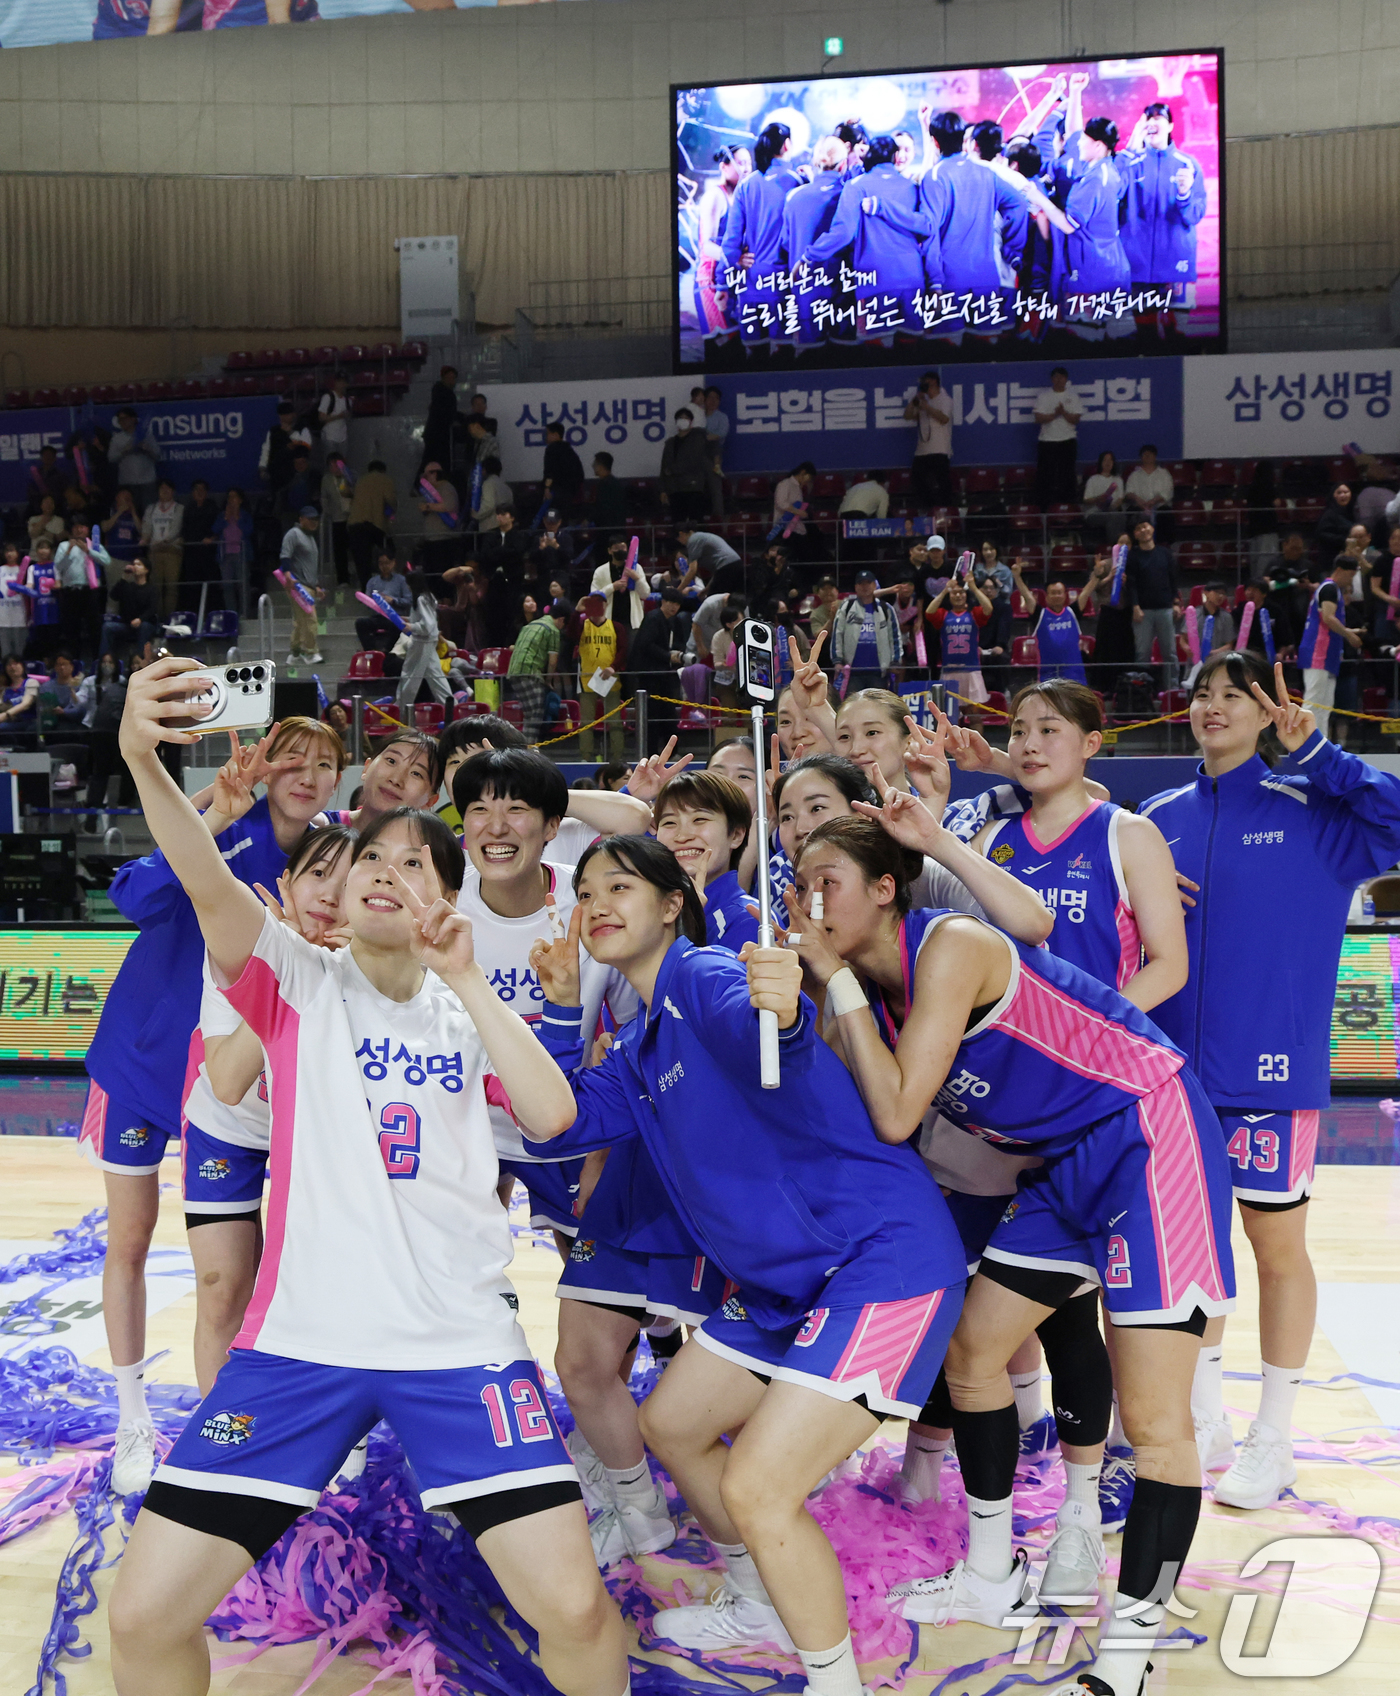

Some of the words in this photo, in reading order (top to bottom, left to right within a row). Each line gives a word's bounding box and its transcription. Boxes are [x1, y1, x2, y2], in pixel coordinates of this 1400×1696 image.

[723, 266, 748, 294] 팬
[755, 263, 834, 295] 여러분과
[838, 259, 878, 293] 함께
[740, 294, 802, 335] 승리를
[810, 294, 905, 331] 뛰어넘는
[911, 287, 1008, 329] 챔프전을
[1011, 289, 1059, 322] 향해
[1066, 286, 1174, 321] 가겠습니다!
[736, 387, 867, 434] 보험을
[1225, 370, 1392, 422] 삼성생명
[515, 396, 666, 447] 삼성생명
[169, 447, 226, 462] Networks
[947, 633, 971, 655] 25
[1242, 830, 1285, 846] 삼성생명
[355, 1037, 464, 1093] 성생명
[657, 1060, 685, 1093] 삼성생명
[1257, 1053, 1290, 1082] 23
[368, 1099, 421, 1180] 2
[1227, 1126, 1280, 1173] 43
[1105, 1233, 1133, 1289] 2
[204, 1418, 231, 1431] BLUE
[480, 1378, 554, 1448] 12
